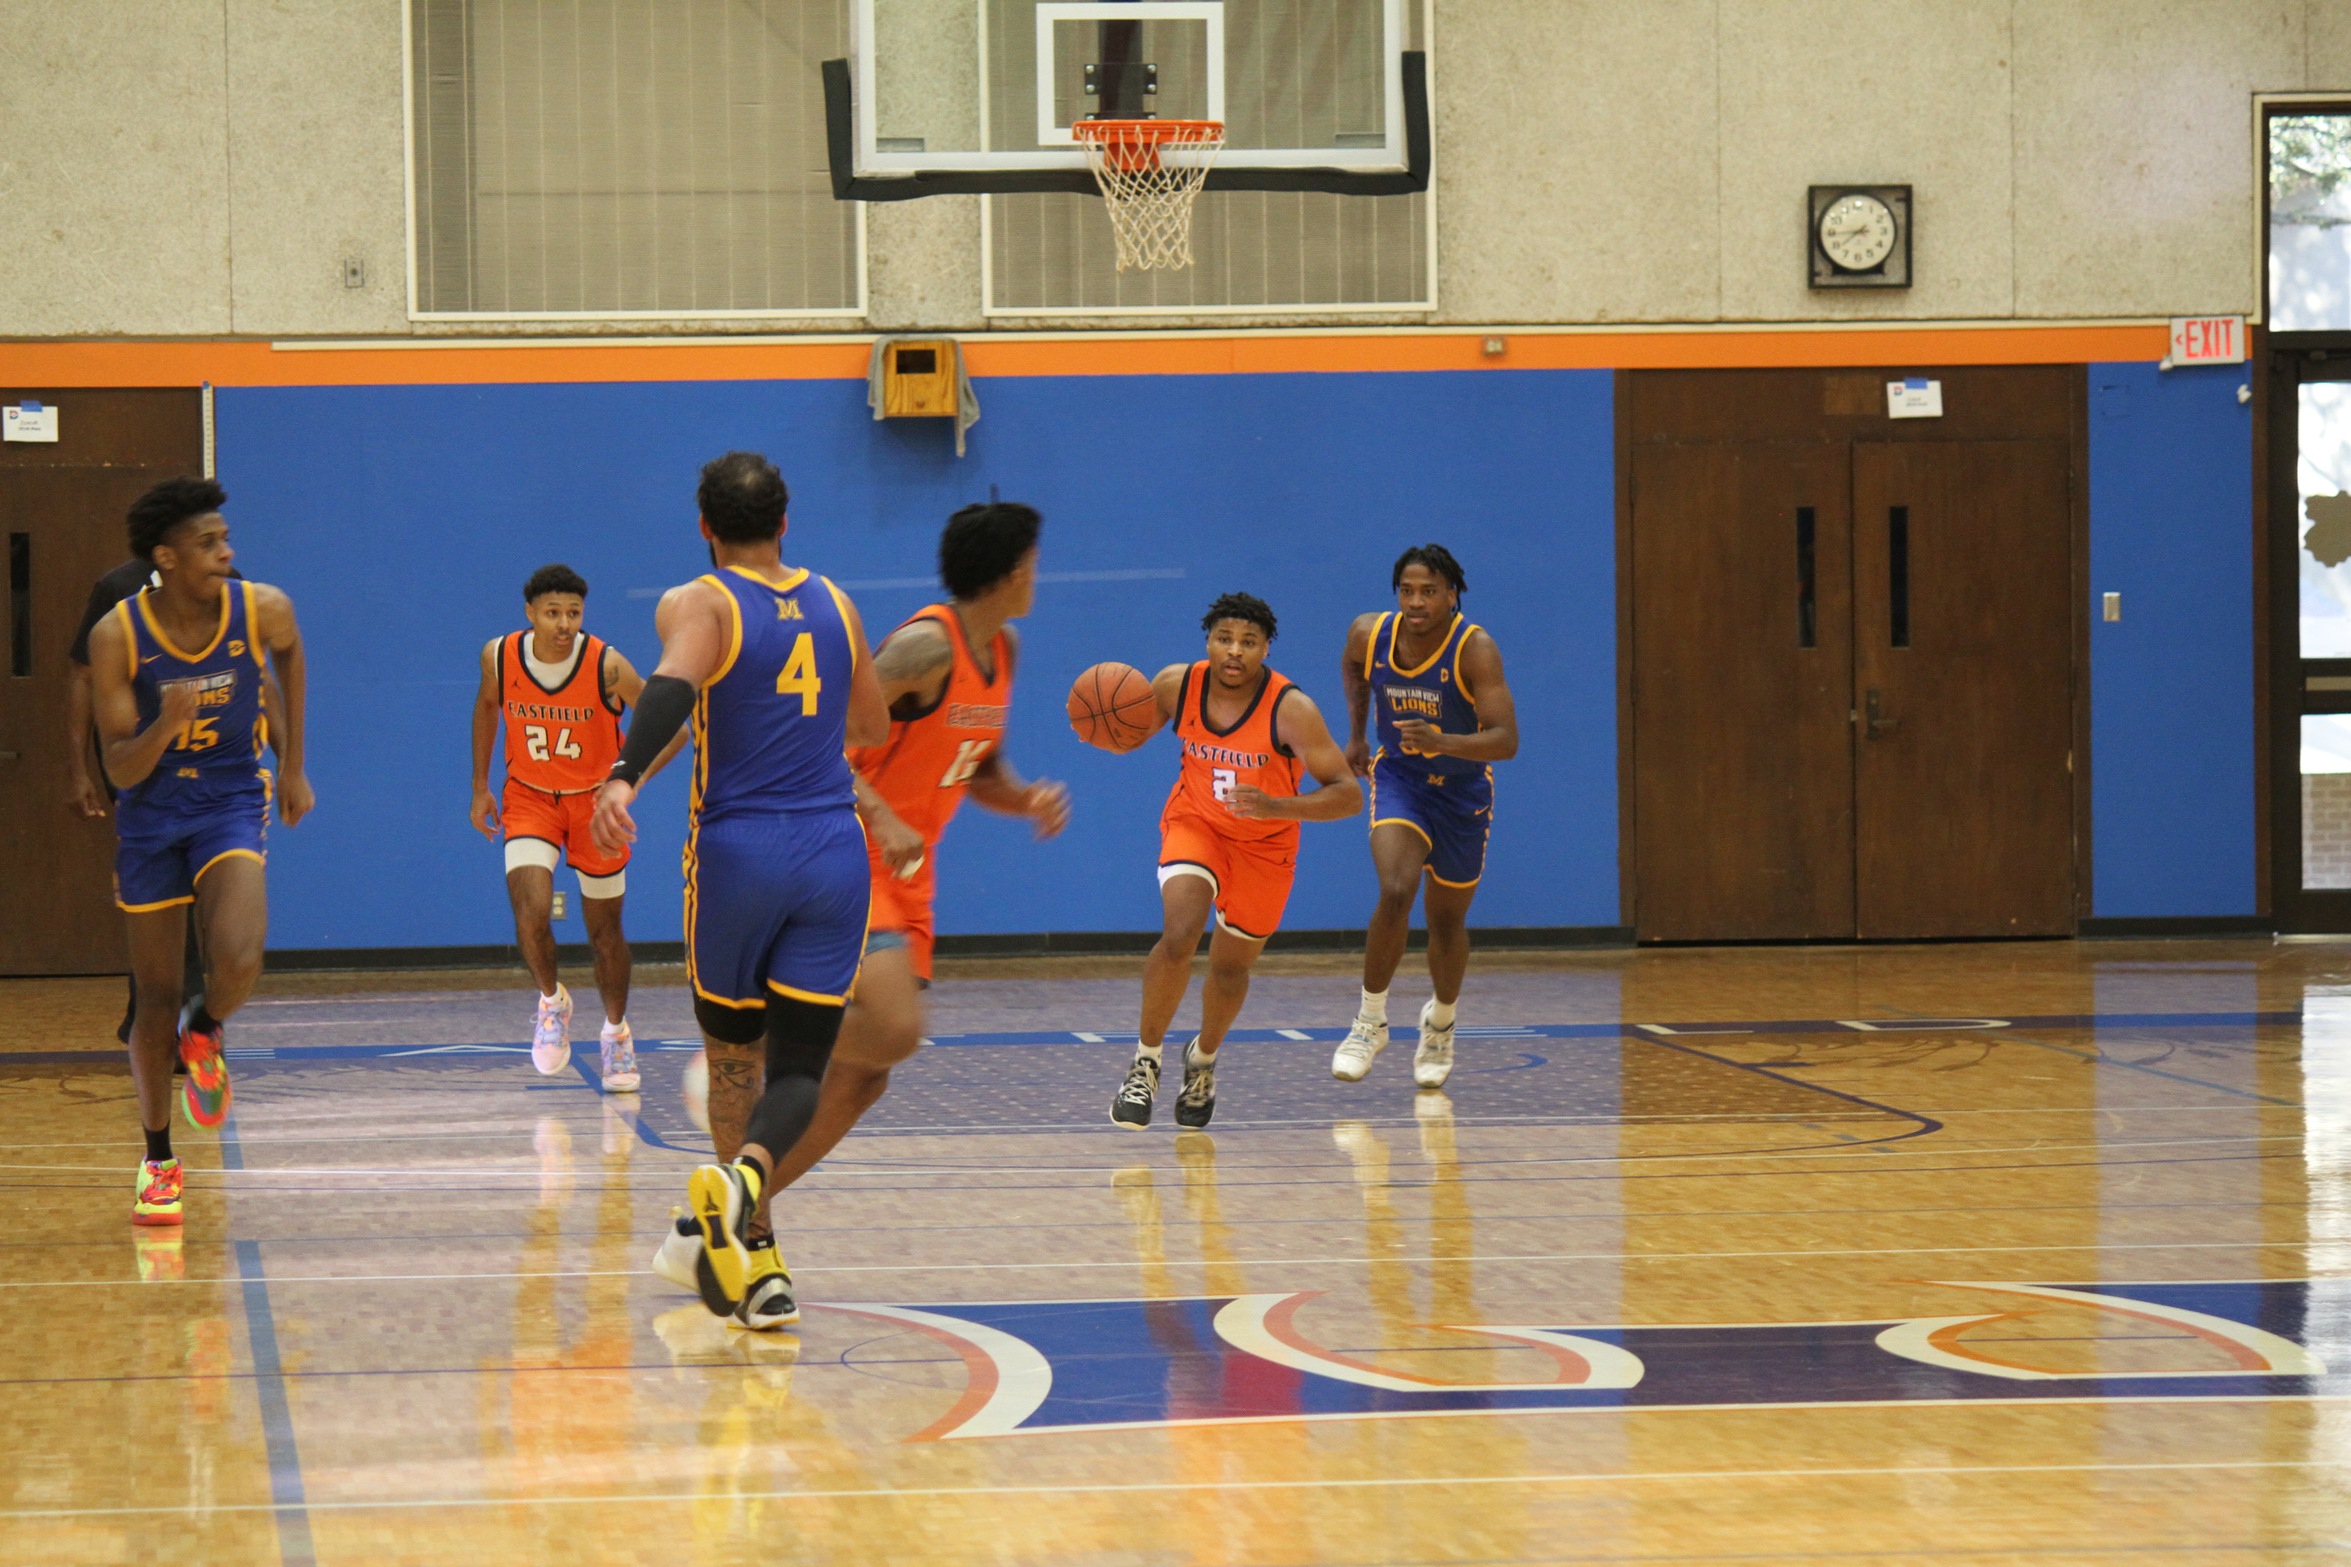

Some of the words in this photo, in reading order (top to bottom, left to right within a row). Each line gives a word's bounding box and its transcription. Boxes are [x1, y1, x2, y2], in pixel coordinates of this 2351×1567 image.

[2185, 320, 2234, 358] EXIT
[774, 596, 805, 620] M
[775, 631, 822, 716] 4
[1386, 687, 1422, 700] MOUNTAIN
[1423, 691, 1440, 702] VIEW
[1390, 697, 1438, 716] LIONS
[507, 700, 594, 722] EASTFIELD
[174, 716, 220, 752] 15
[525, 724, 582, 761] 24
[1212, 766, 1238, 804] 2
[1427, 774, 1445, 787] M
